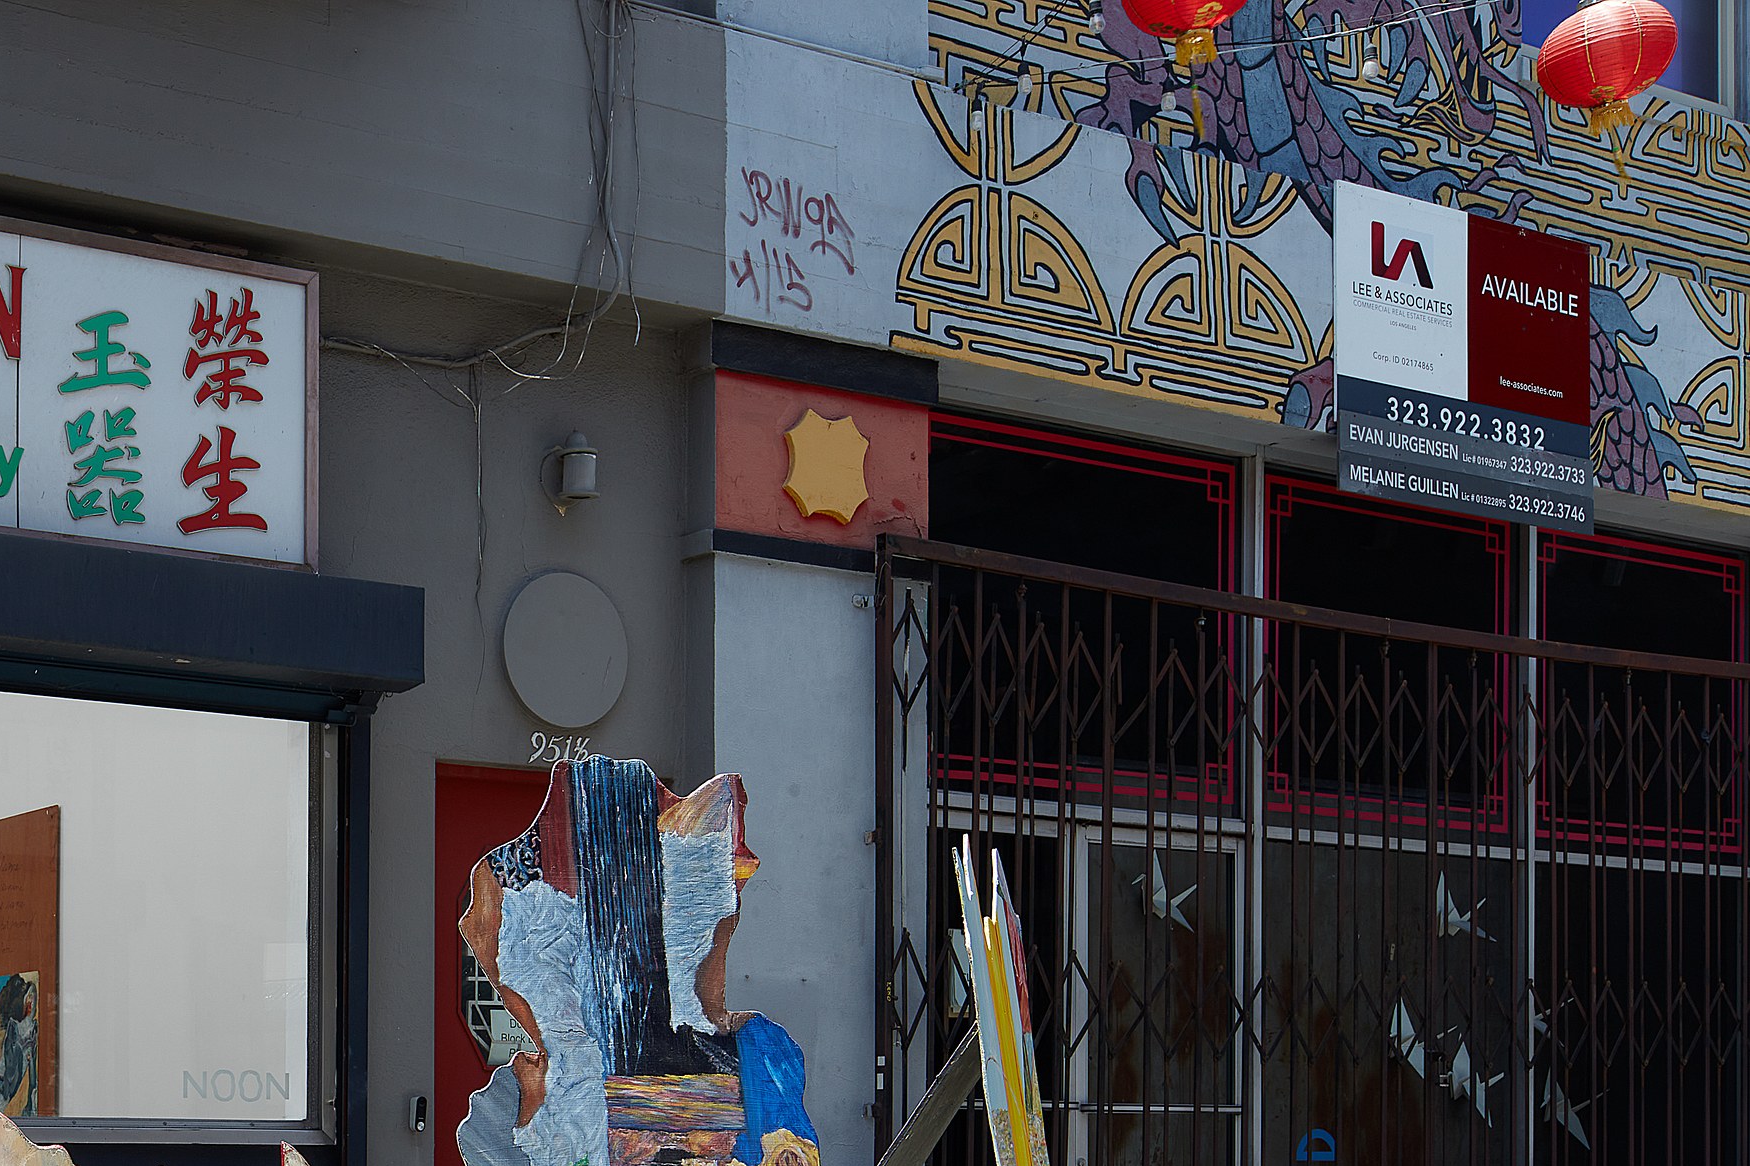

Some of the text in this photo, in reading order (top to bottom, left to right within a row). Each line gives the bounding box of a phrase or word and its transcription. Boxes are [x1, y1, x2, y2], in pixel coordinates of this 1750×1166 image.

[1352, 281, 1453, 316] LEE & ASSOCIATES
[1481, 273, 1579, 317] AVAILABLE
[1353, 299, 1453, 328] COMMERCIAL REAL ESTATE SERVICES
[1372, 351, 1434, 372] Corp. ID 02174865
[1499, 375, 1564, 398] lee-associates.com
[1386, 396, 1546, 451] 323.922.3832
[1349, 424, 1384, 446] EVAN
[1386, 432, 1459, 460] JURGENSEN
[1476, 456, 1507, 470] 01967347
[1510, 456, 1585, 485] 323.922.3733
[1349, 464, 1405, 489] MELANIE
[1408, 476, 1459, 499] GUILLEN
[1476, 495, 1507, 508] 01322895
[1509, 494, 1585, 523] 323.922.3746
[182, 1069, 290, 1102] NOON
